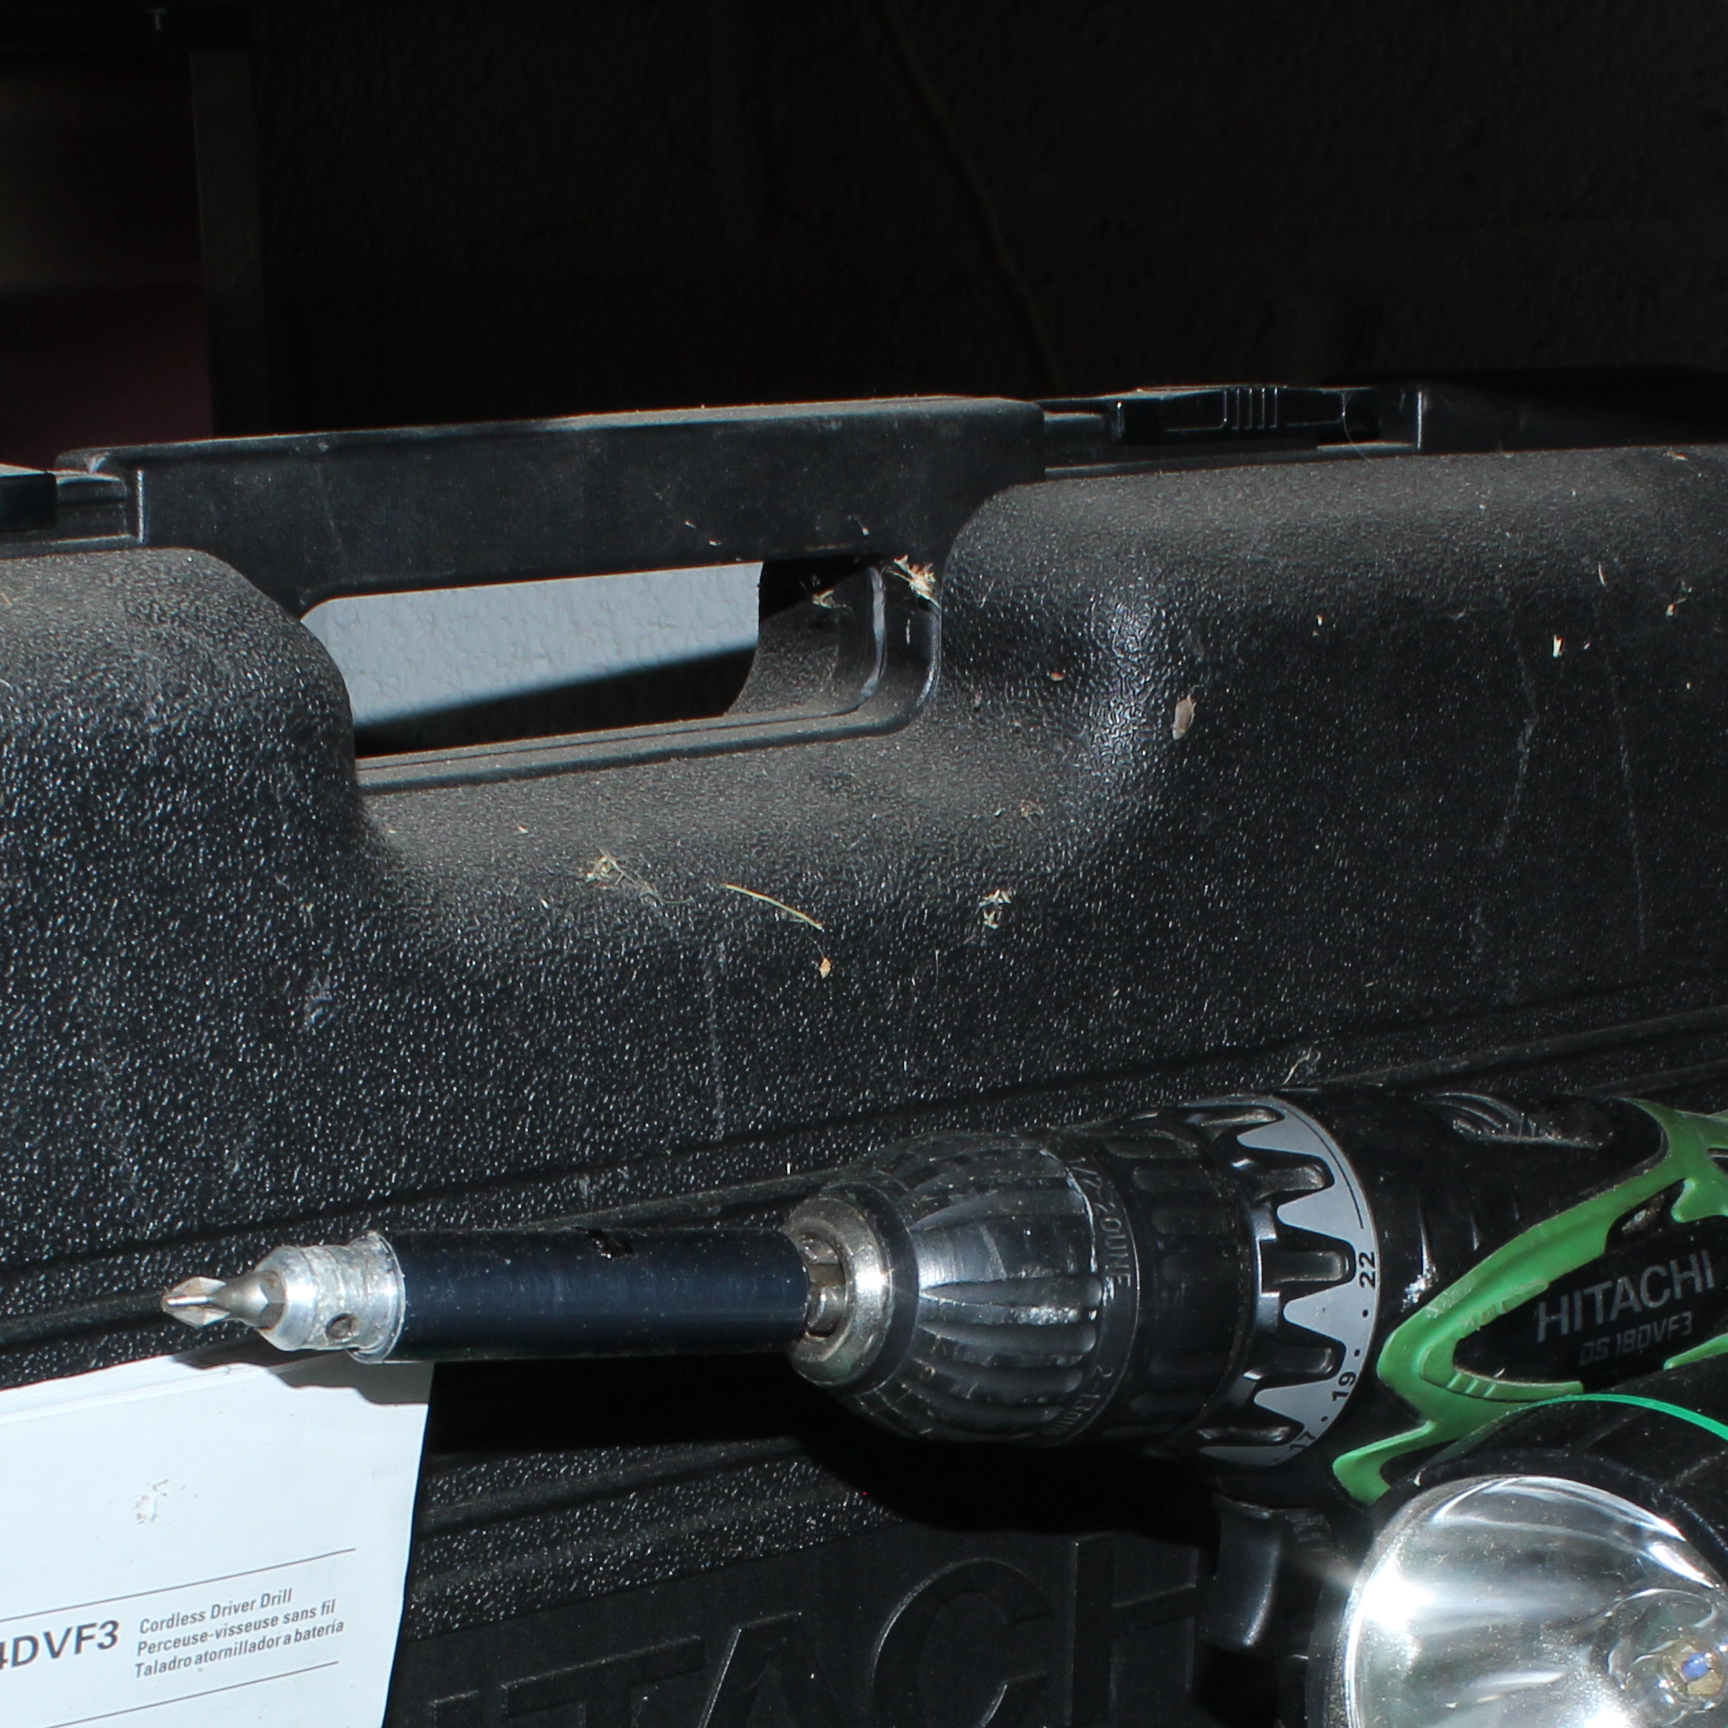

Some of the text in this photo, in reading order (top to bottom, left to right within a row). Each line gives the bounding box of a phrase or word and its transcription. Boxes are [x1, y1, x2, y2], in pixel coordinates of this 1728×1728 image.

[1359, 1251, 1376, 1288] 22
[1536, 1248, 1716, 1344] HITACHI
[1332, 1371, 1357, 1402] 19
[136, 1598, 337, 1658] Perceuse-visseuse sans fil
[139, 1587, 293, 1635] Cordless Driver Drill
[134, 1618, 345, 1679] Taladro atornillador a batería
